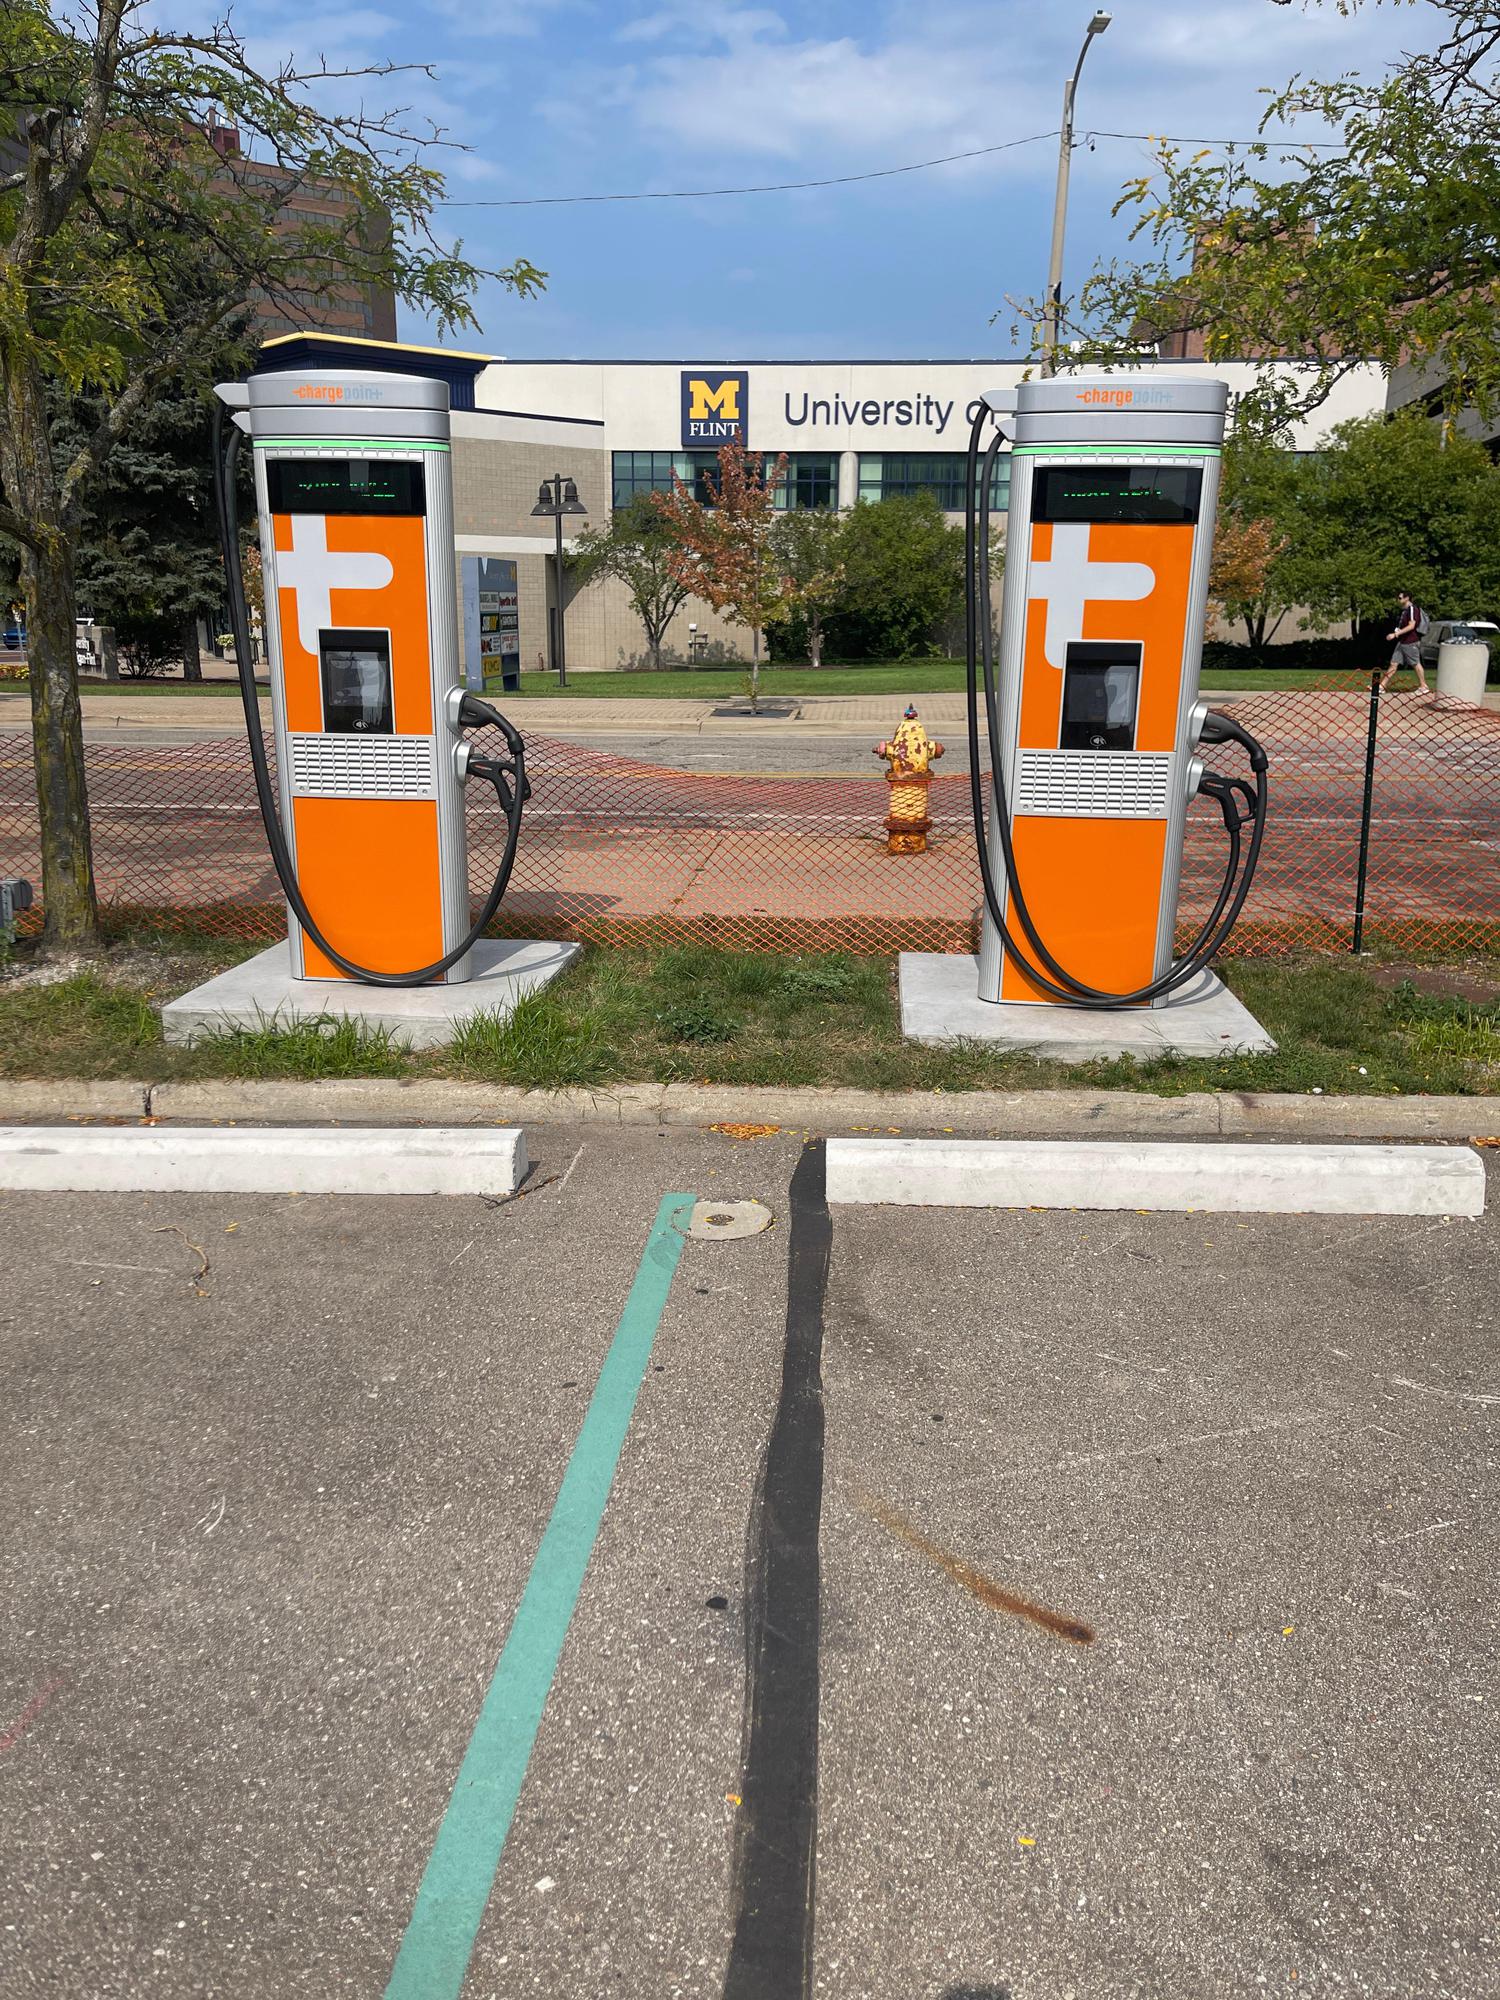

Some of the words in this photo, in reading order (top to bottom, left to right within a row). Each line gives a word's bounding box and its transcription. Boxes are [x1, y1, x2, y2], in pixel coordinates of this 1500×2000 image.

[689, 380, 740, 419] M
[785, 393, 954, 434] University
[966, 400, 995, 426] o
[689, 422, 740, 437] FLINT
